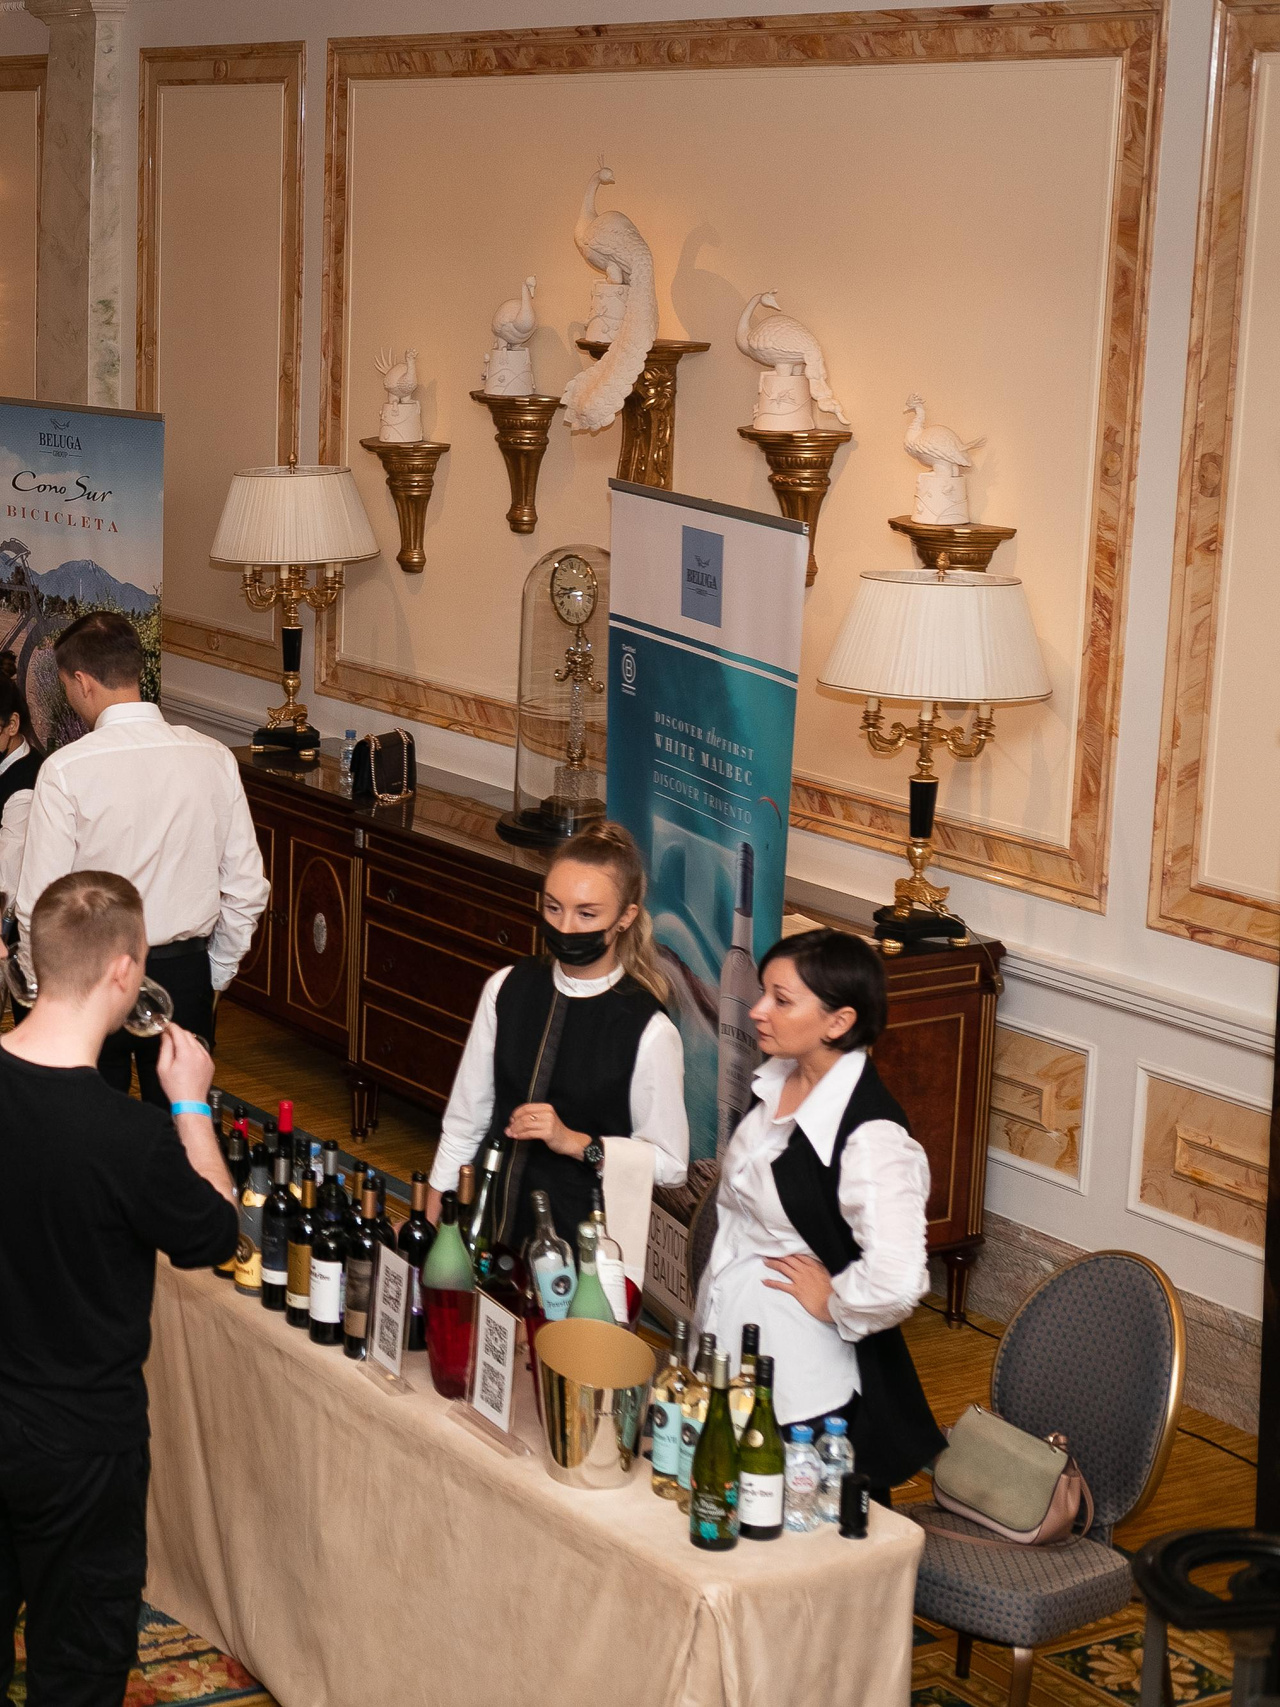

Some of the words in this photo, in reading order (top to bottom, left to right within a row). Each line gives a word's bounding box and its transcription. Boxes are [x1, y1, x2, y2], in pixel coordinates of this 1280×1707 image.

[39, 432, 82, 450] BELUGA
[12, 471, 66, 495] Cono
[65, 475, 113, 502] Sur
[6, 505, 119, 533] BICICLETA
[686, 568, 718, 590] BELUGA
[654, 711, 703, 740] DISCOVER
[706, 727, 721, 748] the
[722, 739, 754, 760] FIRST
[654, 733, 695, 762] WHITE
[701, 751, 753, 786] MALBEC
[653, 770, 699, 801] DISCOVER
[703, 791, 752, 825] TRIVENTO
